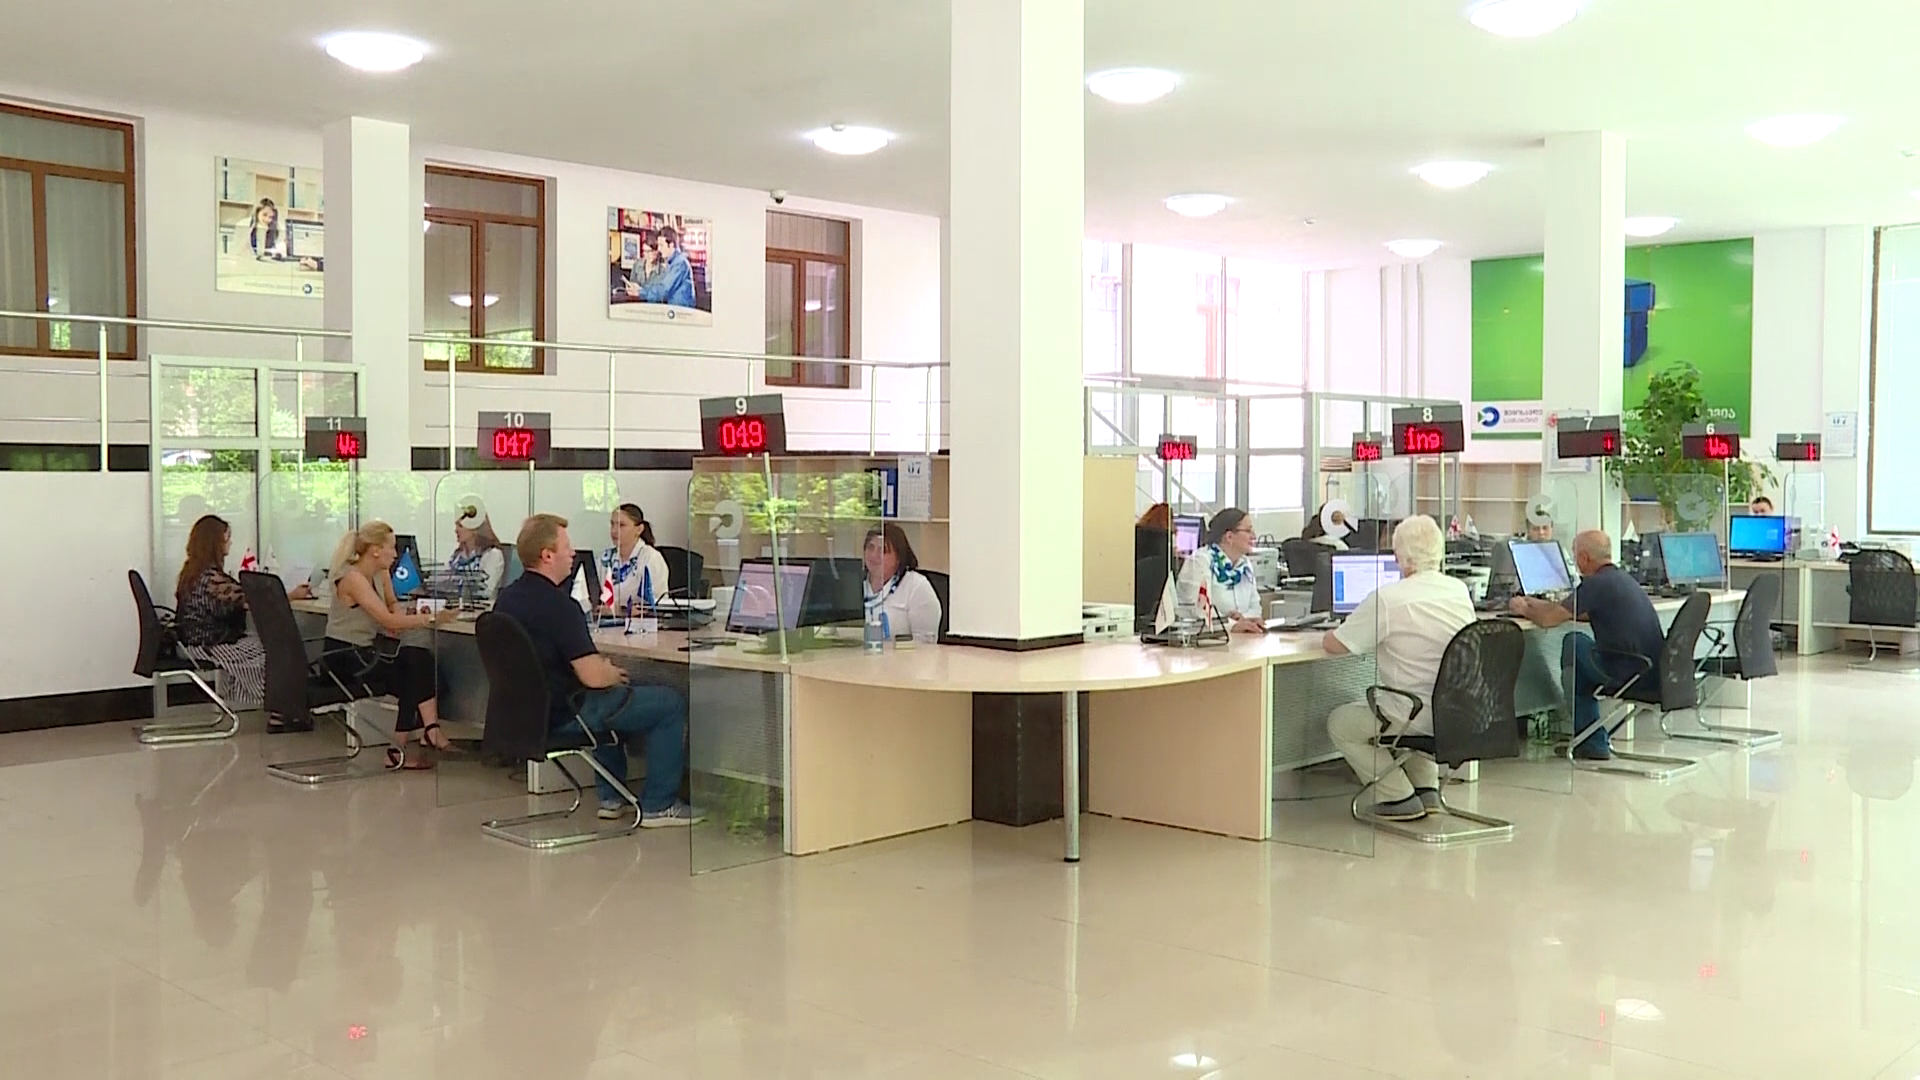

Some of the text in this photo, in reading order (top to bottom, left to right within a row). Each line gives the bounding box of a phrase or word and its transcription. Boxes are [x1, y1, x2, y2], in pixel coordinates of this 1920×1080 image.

[735, 397, 747, 415] 9
[504, 412, 525, 428] 10
[1422, 407, 1433, 422] 8
[326, 418, 342, 430] 11
[1583, 417, 1593, 430] 7
[1706, 423, 1715, 434] 6
[722, 420, 763, 449] 049
[495, 431, 532, 457] 047
